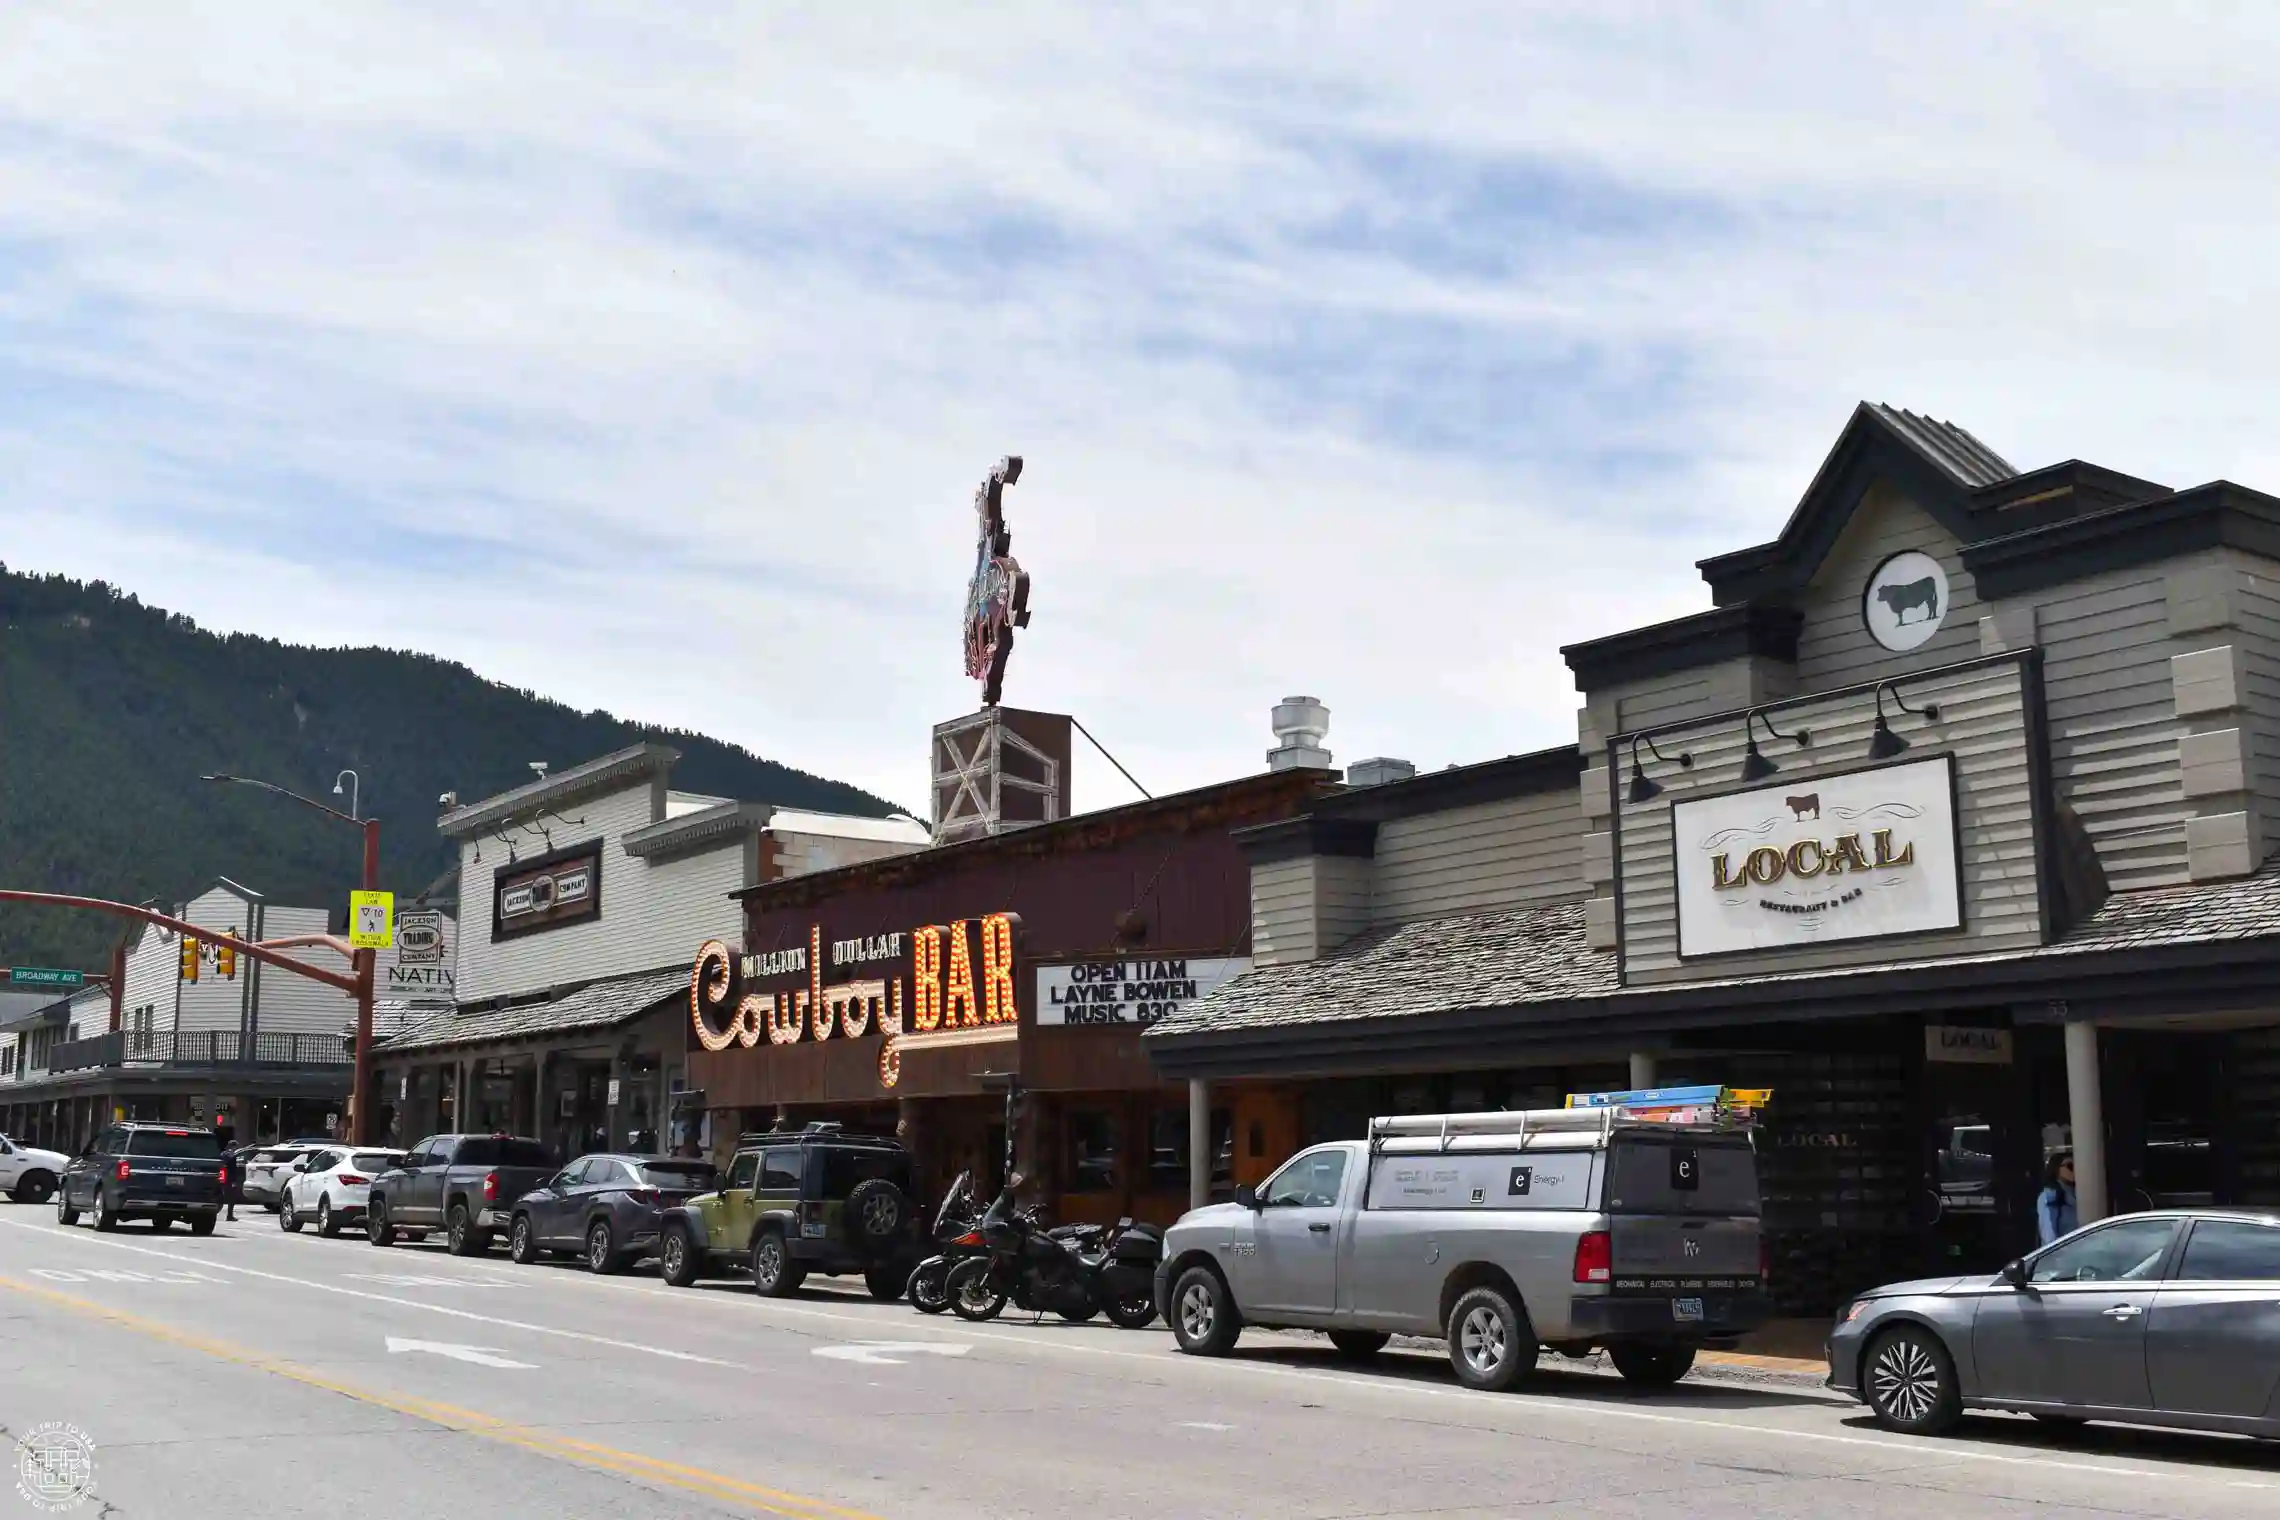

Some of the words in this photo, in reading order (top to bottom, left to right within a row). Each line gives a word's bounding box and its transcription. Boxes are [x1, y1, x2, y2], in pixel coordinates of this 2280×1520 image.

[1710, 828, 1914, 890] LOCAL
[559, 878, 586, 893] COMPANY
[1841, 887, 1863, 904] BAR
[403, 915, 437, 926] JACKSON
[403, 932, 434, 945] TRADING
[402, 952, 436, 961] COMPANY
[741, 947, 806, 979] MILLION
[832, 932, 902, 964] DOLLAR
[16, 971, 60, 981] BROADWAY
[62, 974, 77, 982] AVE
[1071, 960, 1127, 983] OPEN
[1136, 959, 1187, 980] 11AM
[691, 924, 905, 1089] Cowboy
[913, 912, 1019, 1032] BAR
[1050, 983, 1118, 1004] LAYNE
[1123, 979, 1197, 1001] BOWEN
[1064, 1003, 1126, 1024] MUSIC
[1136, 1001, 1179, 1022] 830
[1941, 1030, 2004, 1050] LOCAL
[1776, 1132, 1859, 1147] LOCAL
